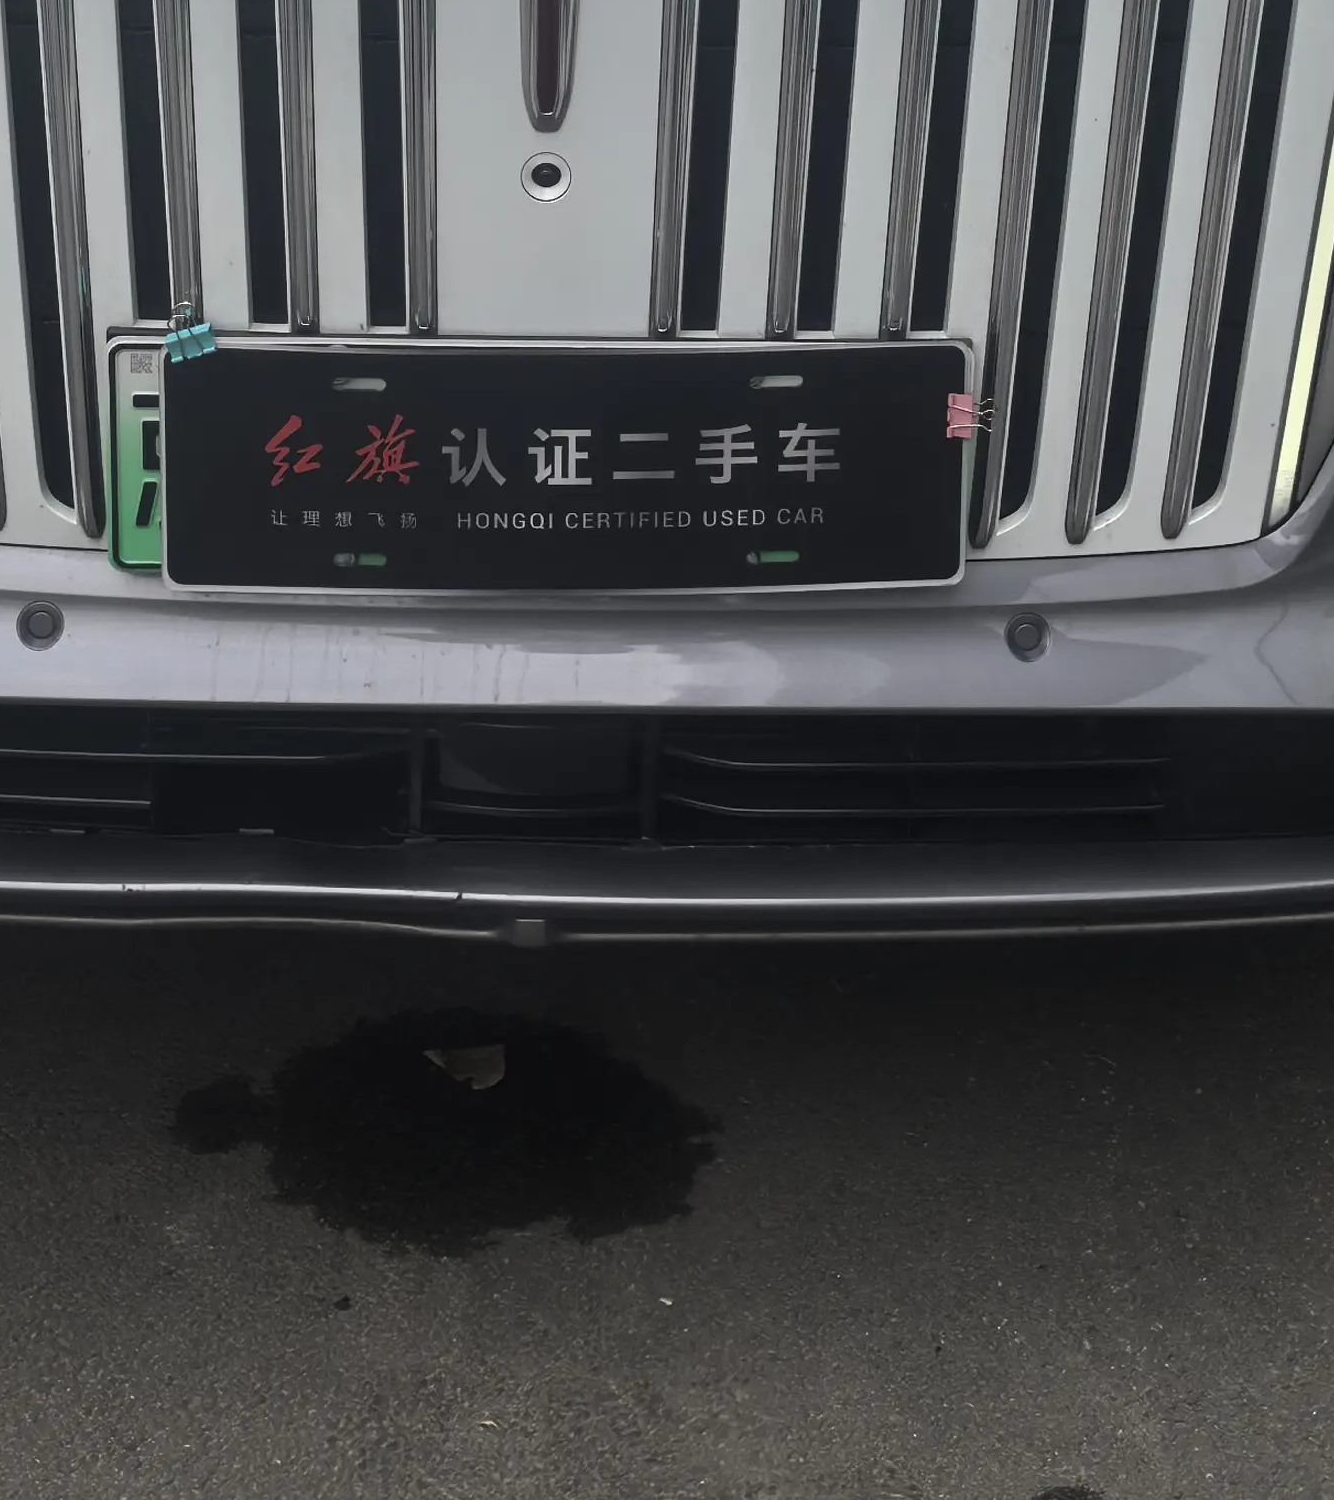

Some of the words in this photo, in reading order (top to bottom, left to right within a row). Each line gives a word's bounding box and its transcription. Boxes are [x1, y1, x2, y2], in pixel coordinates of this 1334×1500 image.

[270, 509, 418, 529] 让理想飞扬
[457, 511, 554, 530] HONGQI
[564, 510, 692, 530] CERTIFIED
[702, 508, 766, 528] USED
[776, 506, 825, 526] CAR
